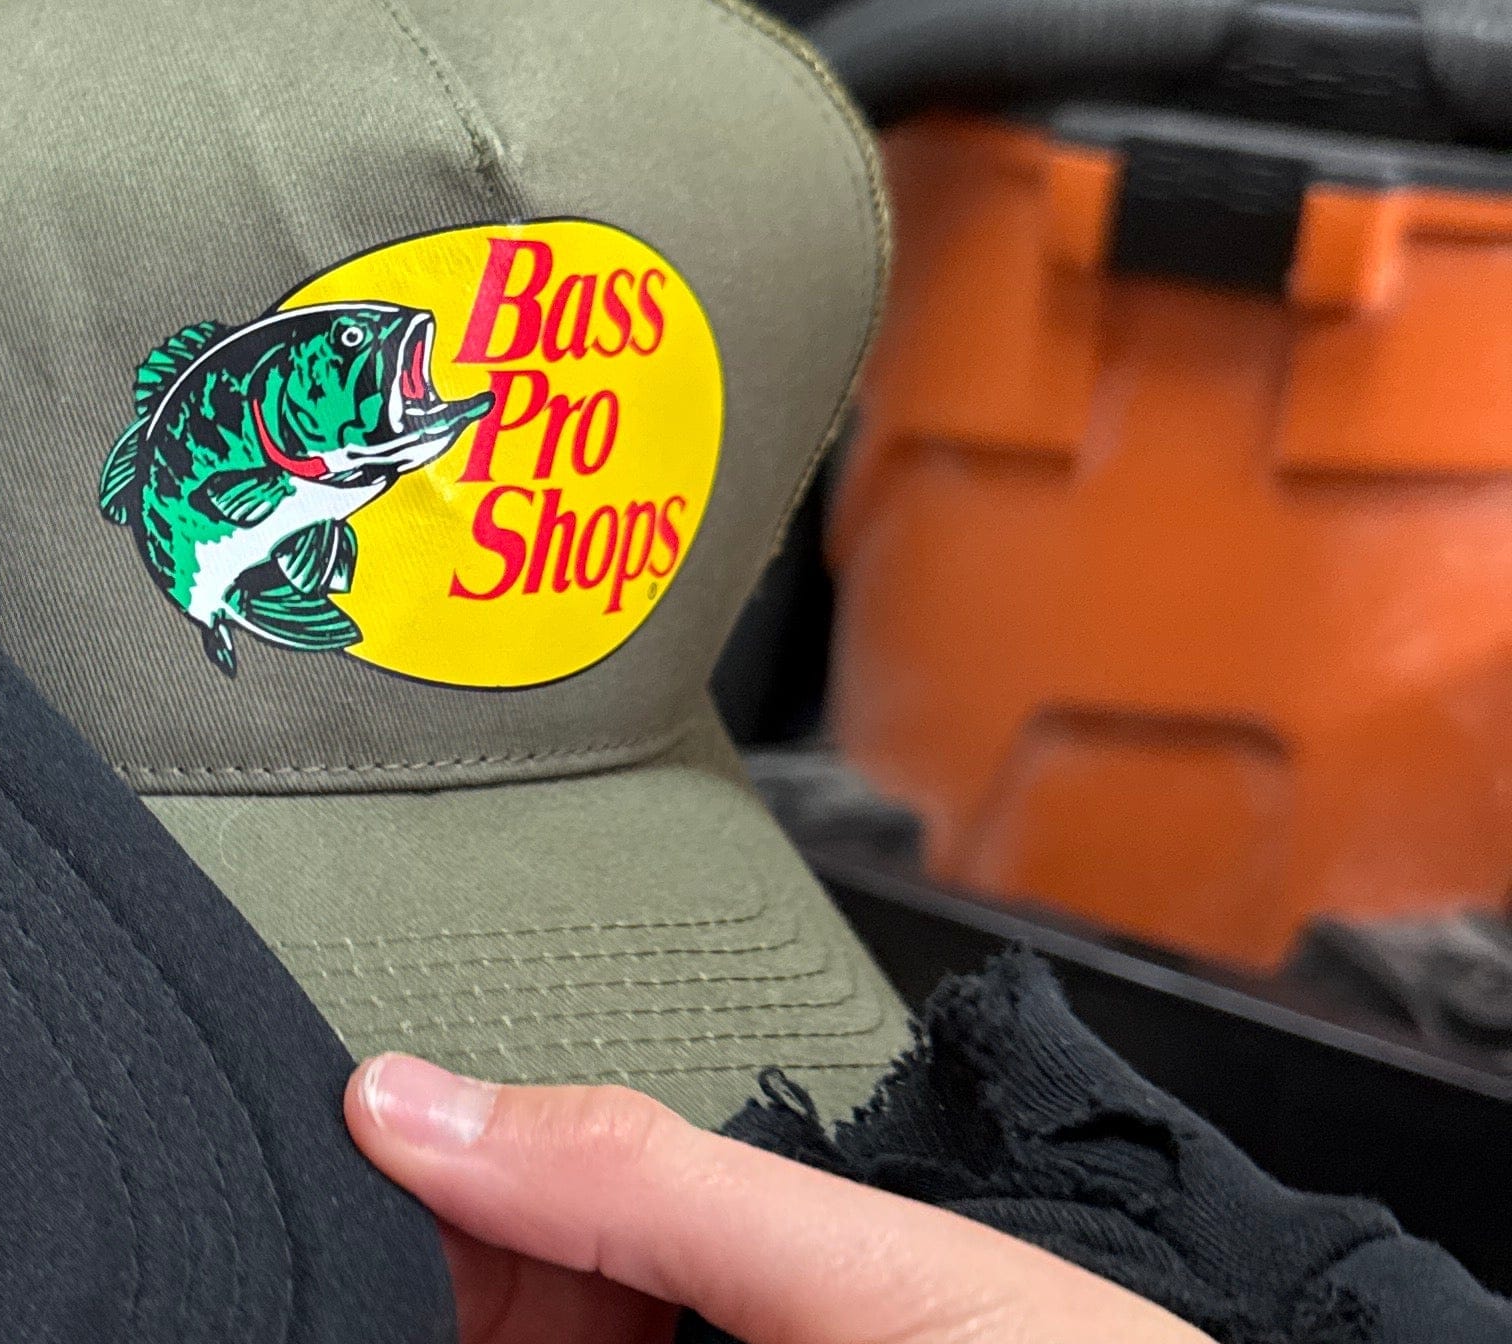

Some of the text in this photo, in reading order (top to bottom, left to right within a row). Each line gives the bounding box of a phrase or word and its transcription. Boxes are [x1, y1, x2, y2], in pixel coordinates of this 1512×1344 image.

[452, 237, 669, 363] Bass
[459, 369, 620, 484] Pro
[450, 485, 687, 614] Shops
